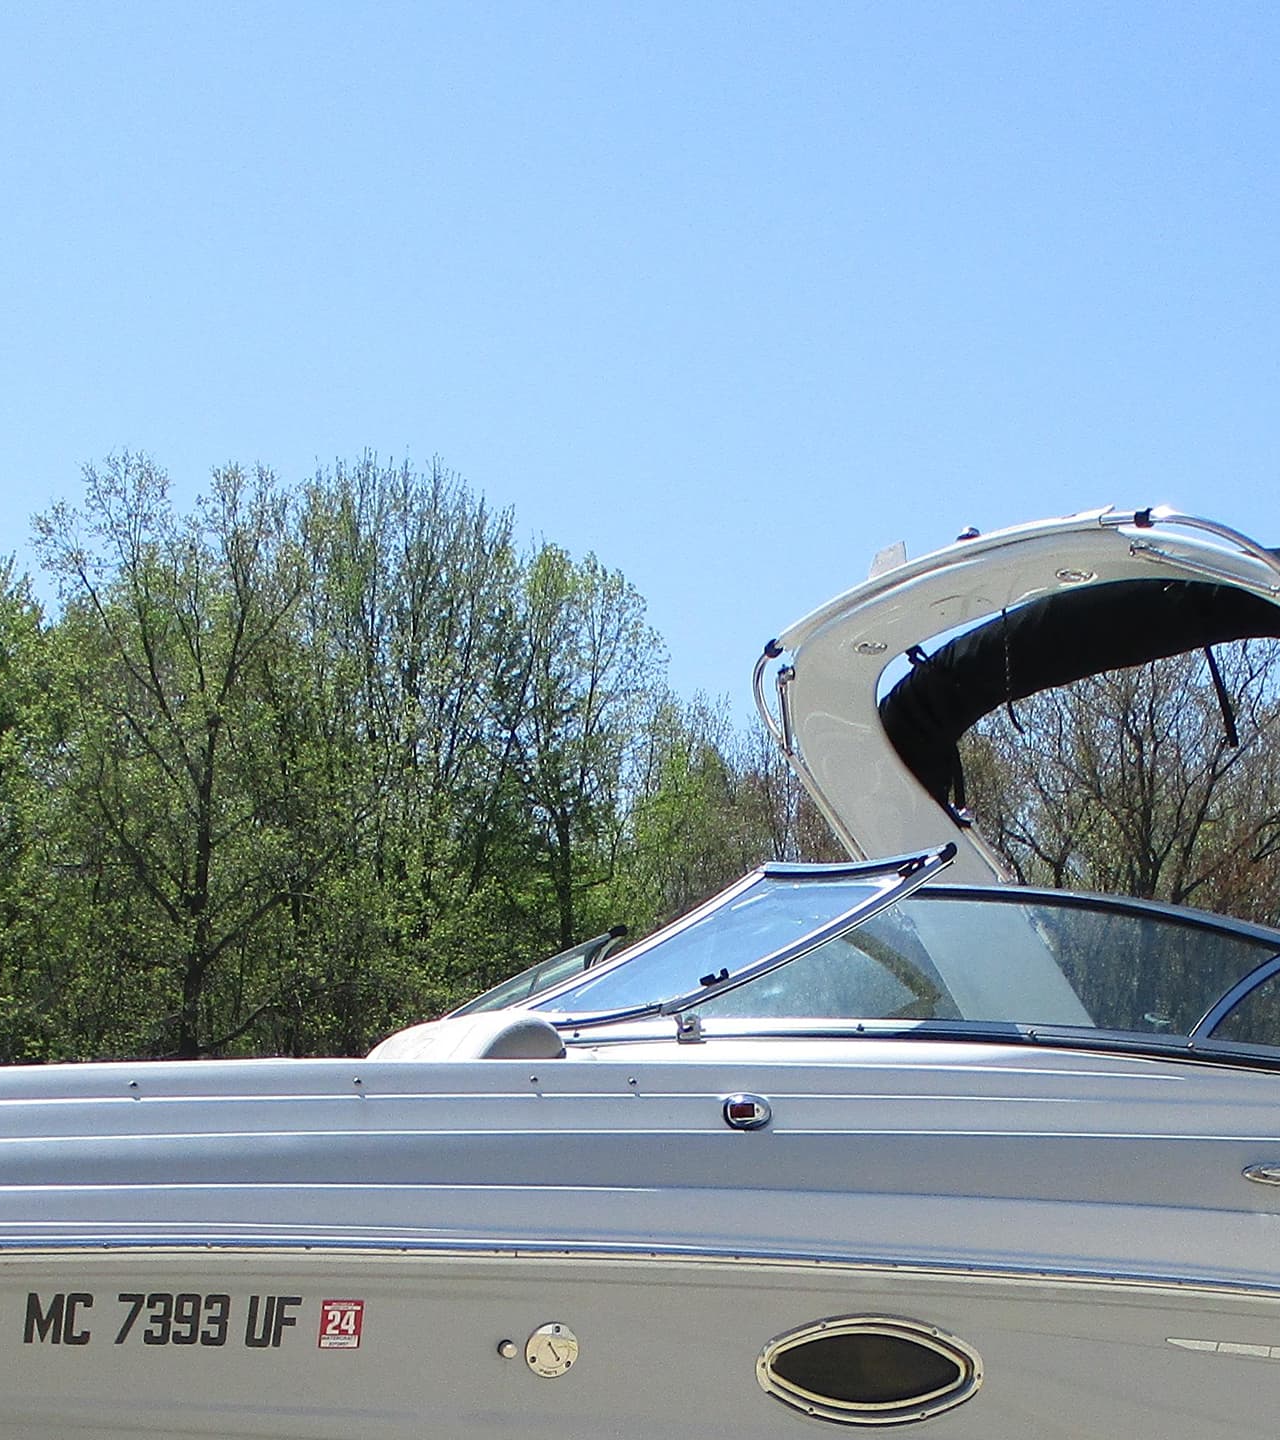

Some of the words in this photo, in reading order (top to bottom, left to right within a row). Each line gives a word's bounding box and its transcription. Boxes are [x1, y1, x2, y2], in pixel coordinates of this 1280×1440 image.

[23, 1292, 94, 1345] MC
[114, 1293, 231, 1346] 7393
[245, 1296, 303, 1348] UF
[326, 1310, 356, 1335] 24
